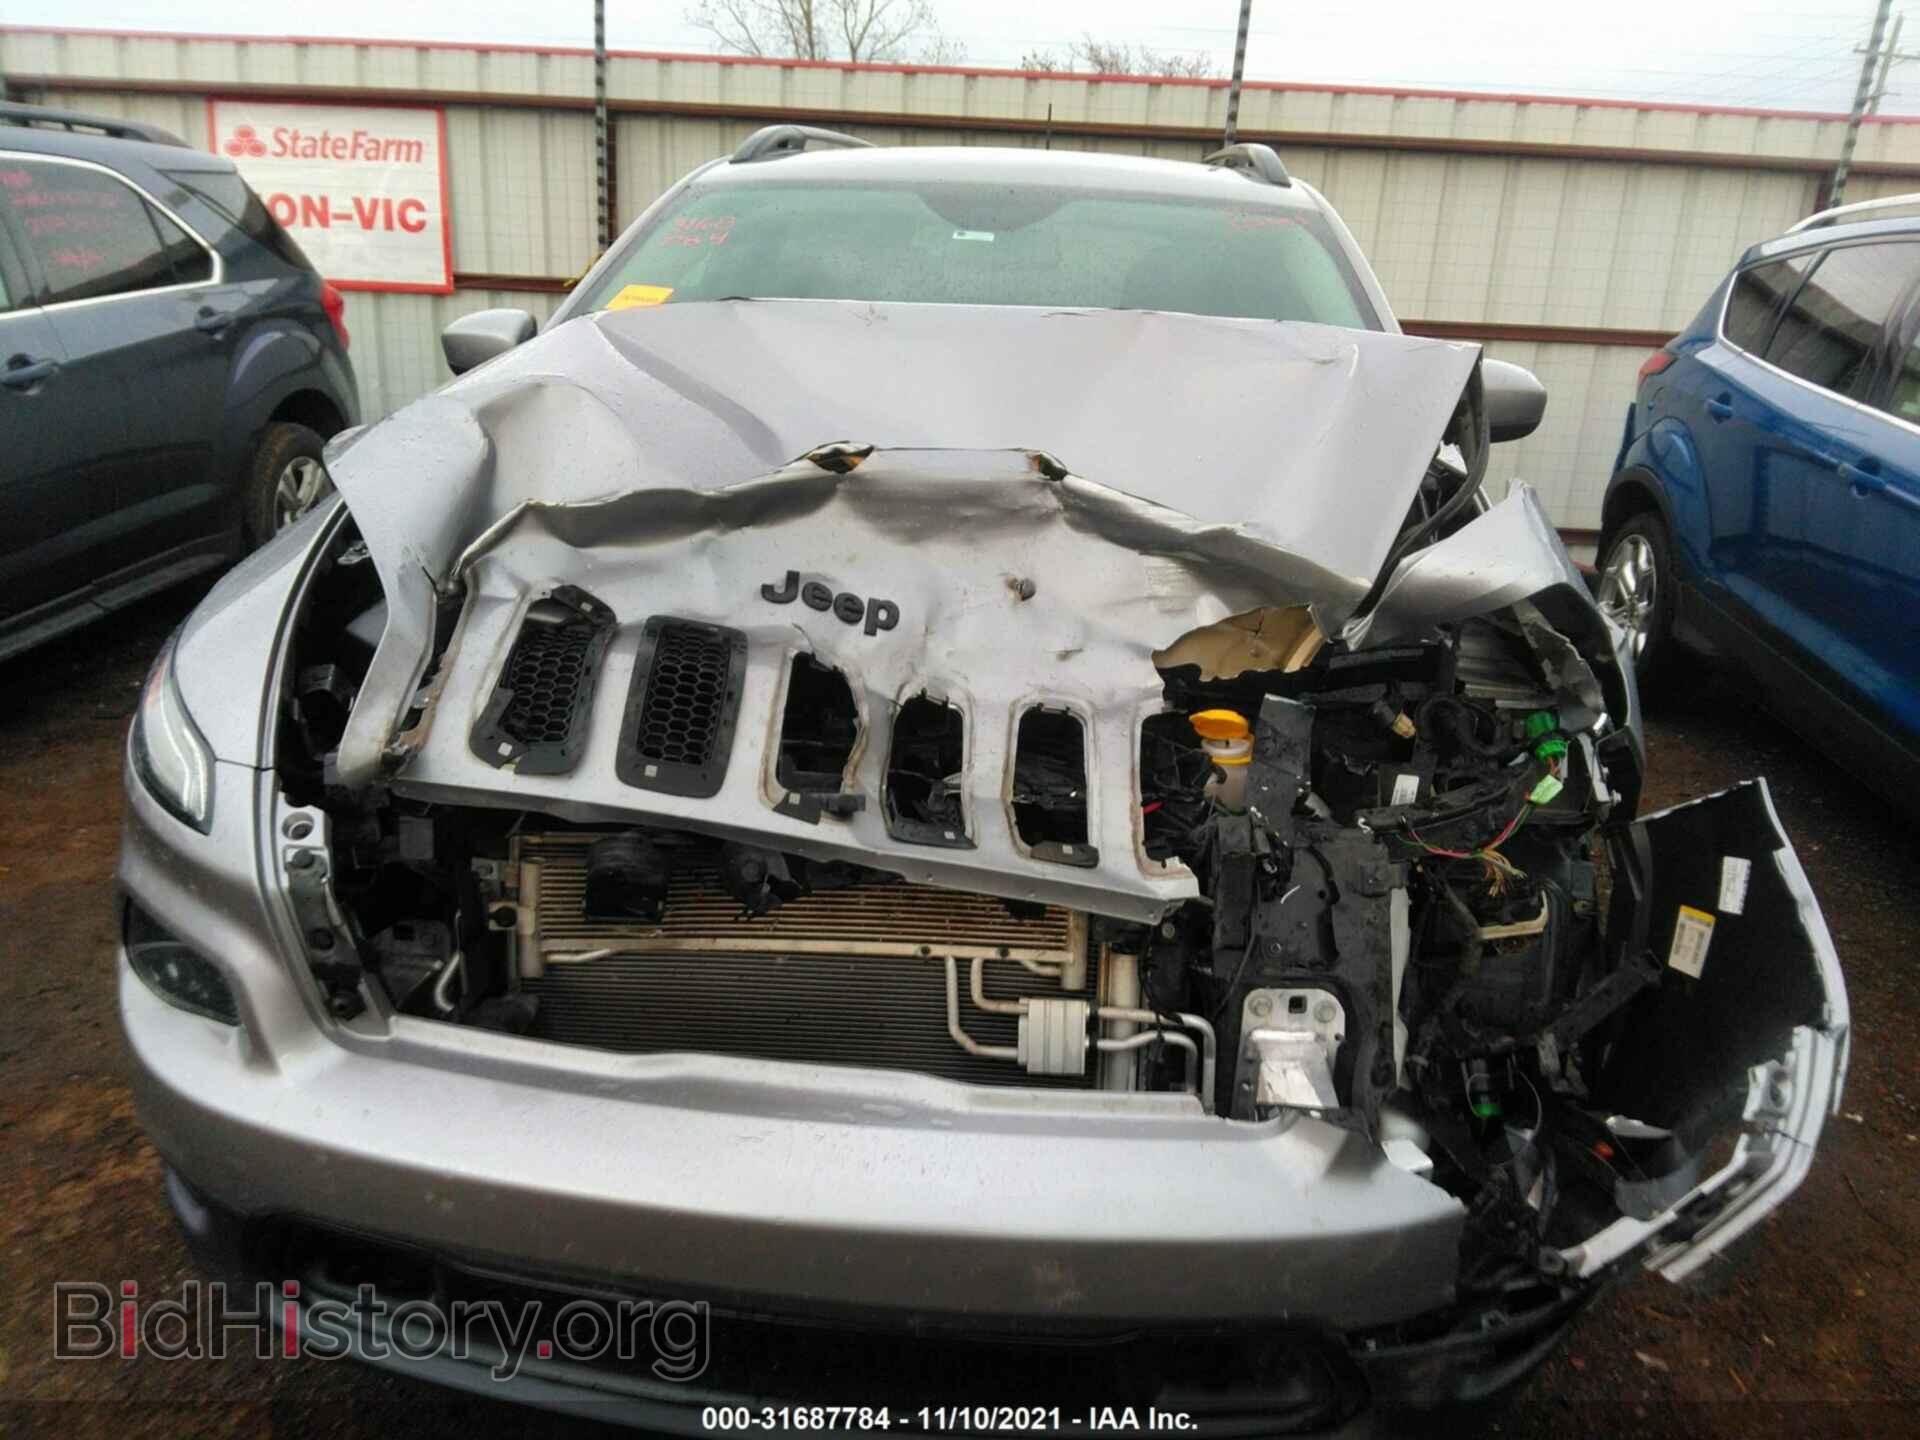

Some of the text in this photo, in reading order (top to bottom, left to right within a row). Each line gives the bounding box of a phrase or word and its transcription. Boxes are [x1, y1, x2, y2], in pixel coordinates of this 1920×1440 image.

[271, 127, 424, 162] StateFarm
[264, 192, 427, 233] ON-VIC
[760, 569, 900, 636] Jeep
